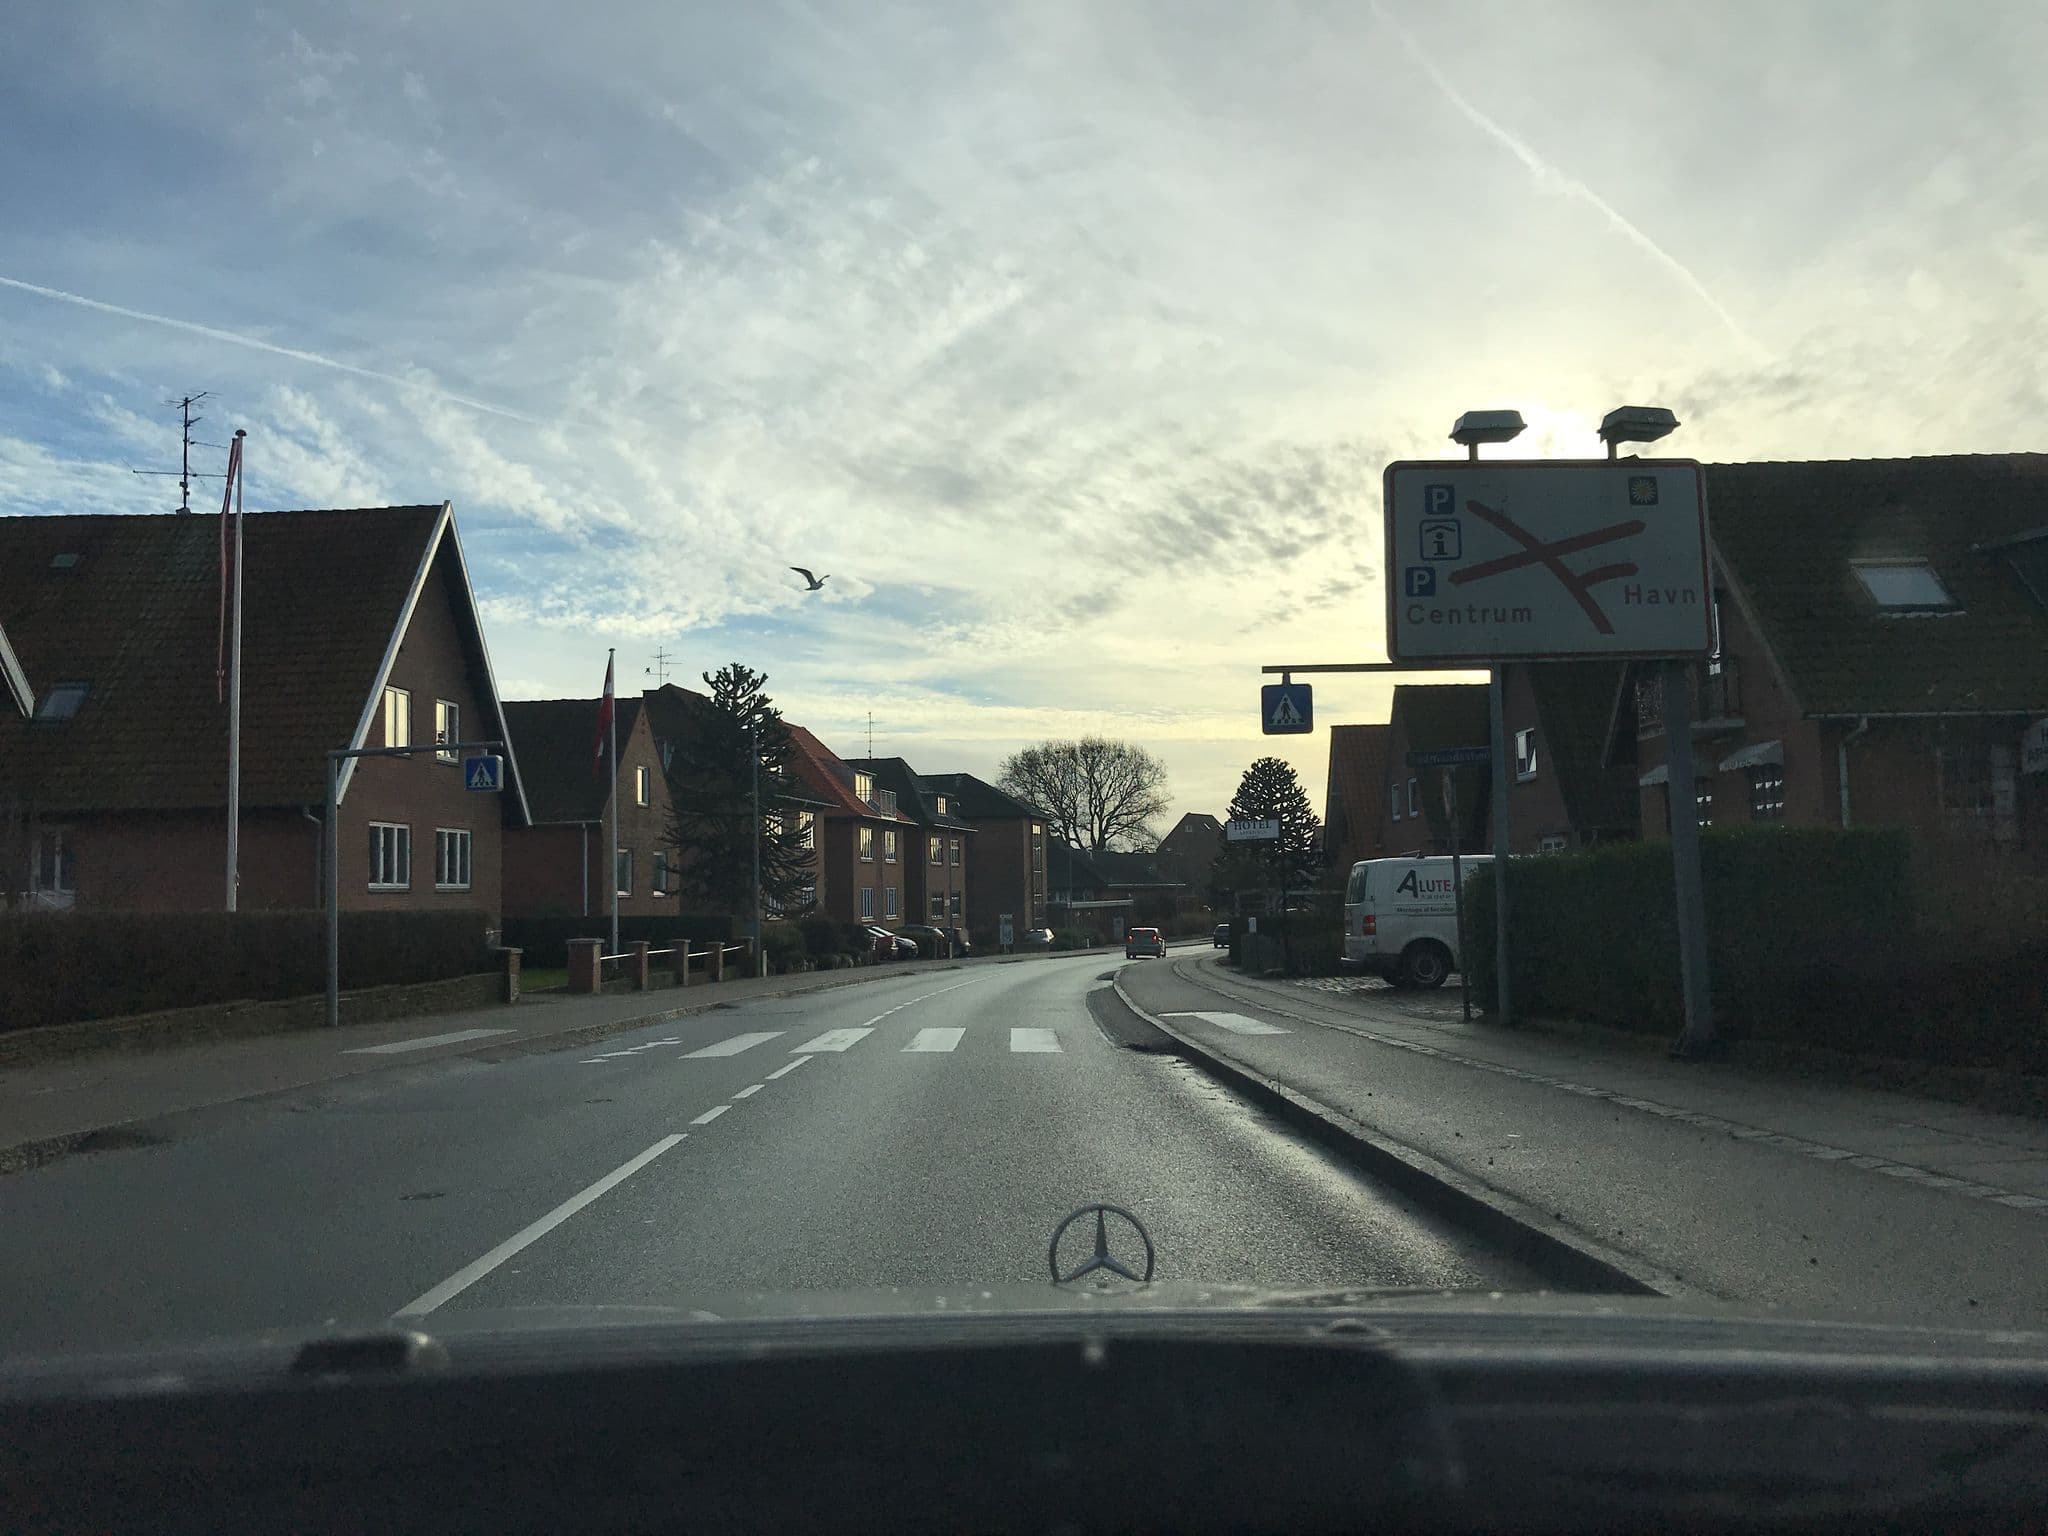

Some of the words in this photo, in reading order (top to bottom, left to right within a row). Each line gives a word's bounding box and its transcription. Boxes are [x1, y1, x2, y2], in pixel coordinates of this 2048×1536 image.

[1432, 487, 1449, 512] P
[1412, 569, 1431, 595] P
[1624, 583, 1697, 605] Havn
[1407, 603, 1533, 625] Centrum
[1234, 820, 1272, 831] HOTEL
